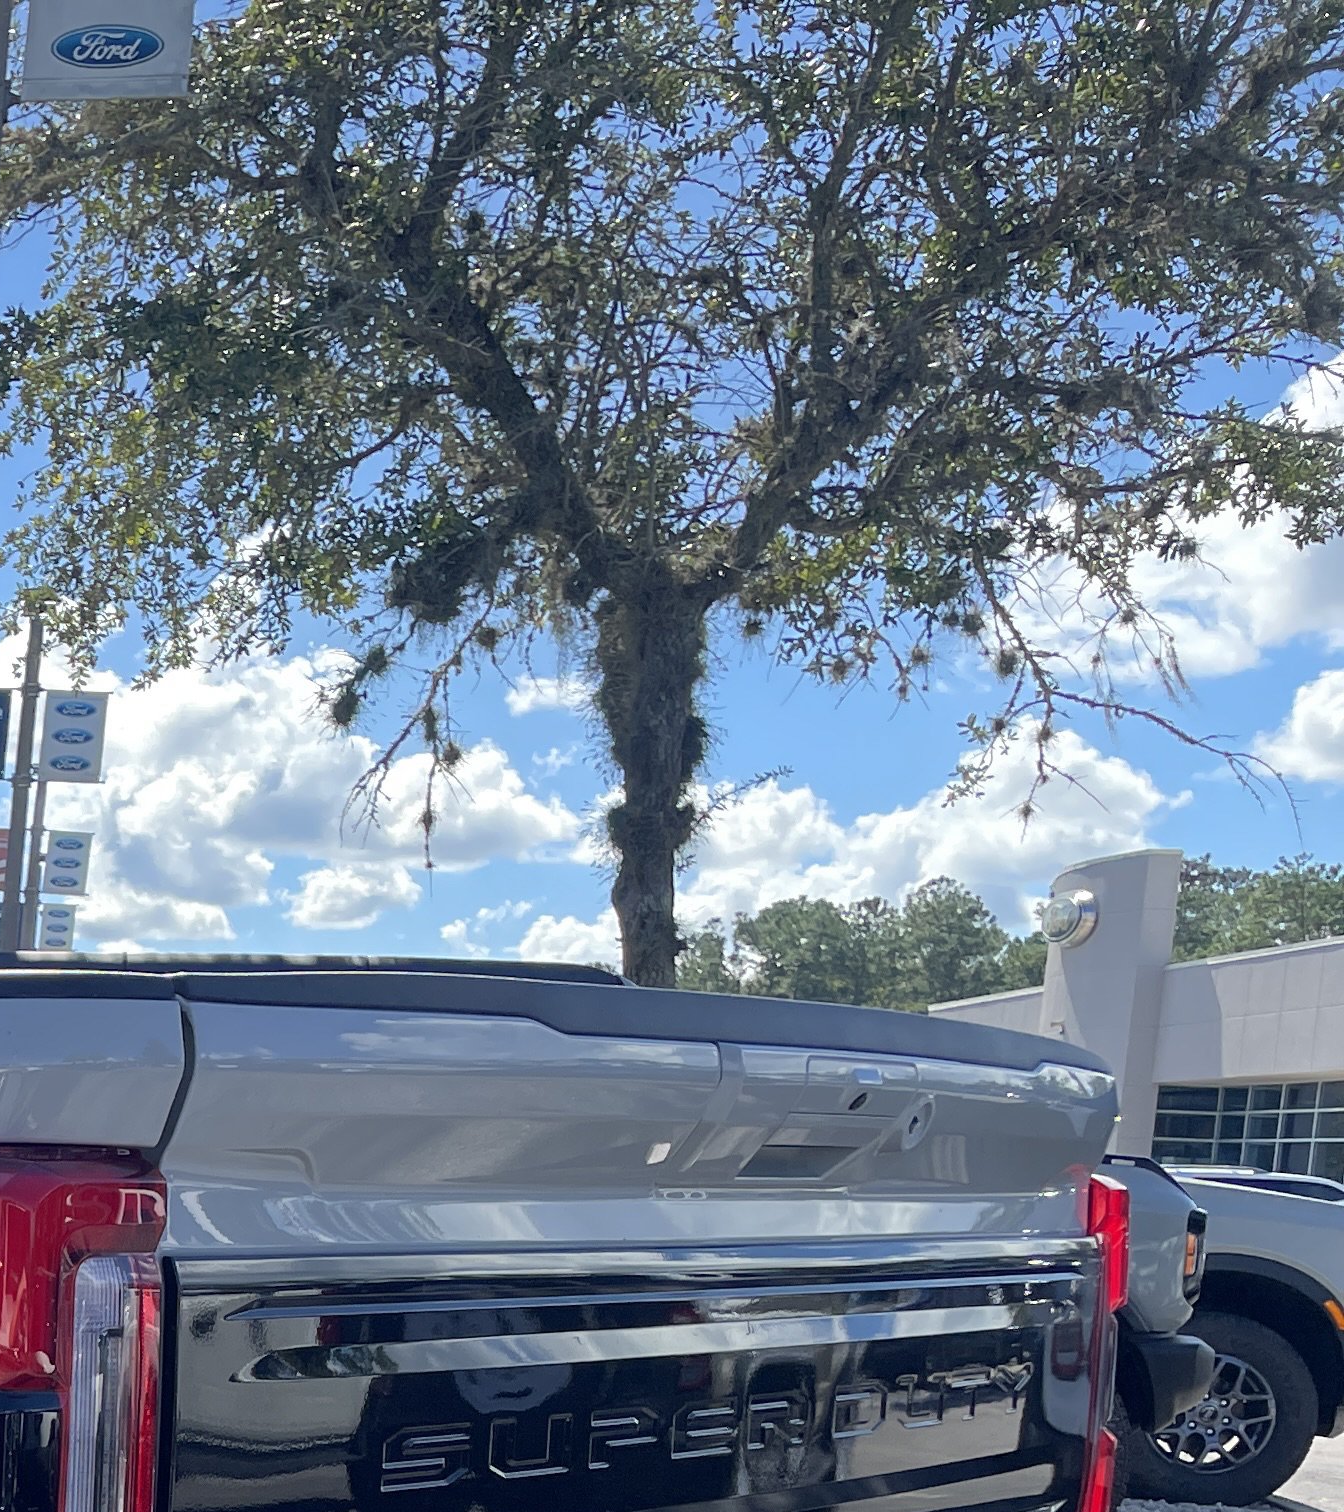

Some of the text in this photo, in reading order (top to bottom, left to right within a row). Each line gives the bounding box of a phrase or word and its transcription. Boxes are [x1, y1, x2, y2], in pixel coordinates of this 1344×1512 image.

[72, 31, 142, 63] Ford
[380, 1361, 1035, 1493] SUPER DUTY
